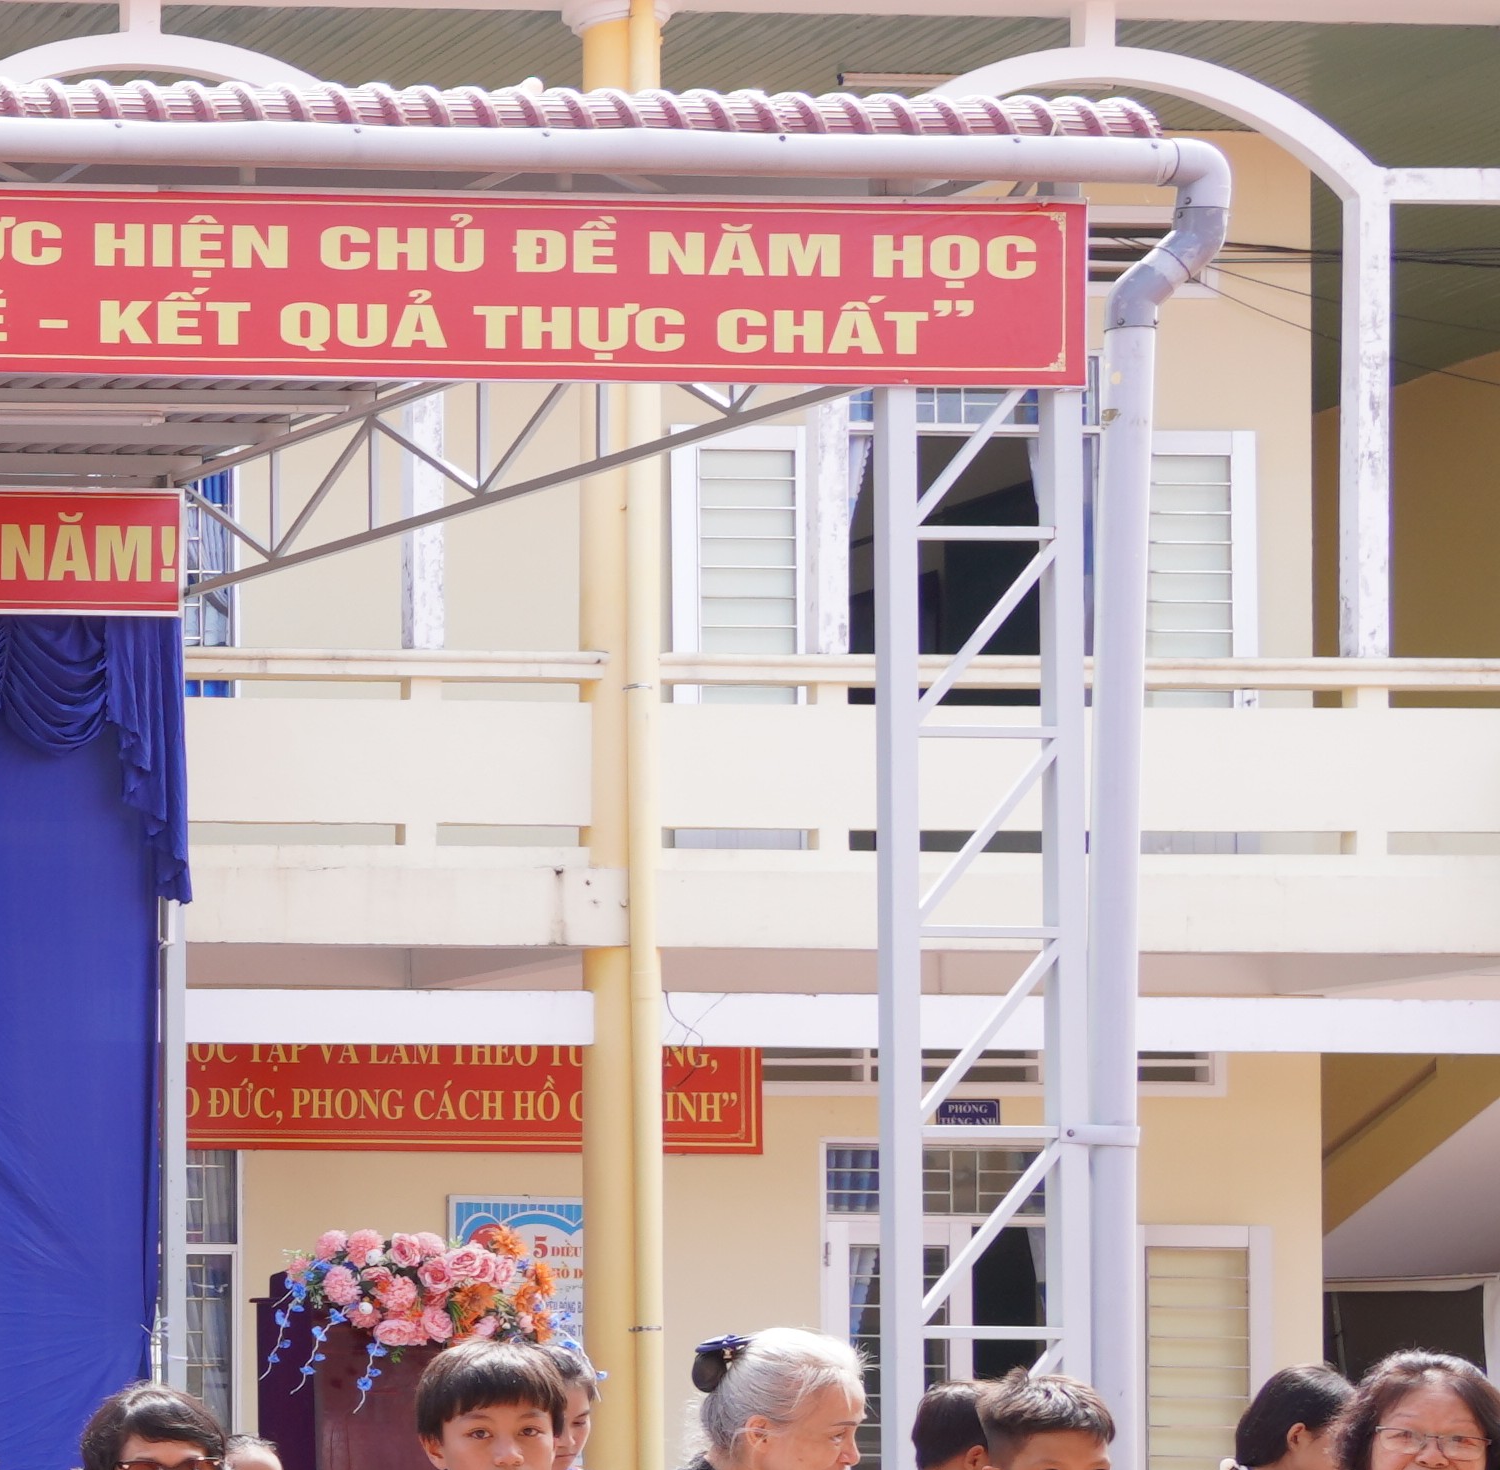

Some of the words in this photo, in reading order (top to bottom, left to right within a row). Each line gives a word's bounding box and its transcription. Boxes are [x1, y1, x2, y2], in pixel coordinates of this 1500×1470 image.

[95, 215, 288, 276] HIỆN
[320, 214, 484, 273] CHỦ
[512, 216, 617, 274] ĐỀ
[649, 223, 840, 277] NĂM
[873, 235, 1036, 290] HỌC
[100, 287, 251, 346] KẾT
[280, 289, 447, 351] QUẢ
[473, 303, 685, 361] THỰC
[1, 511, 180, 583] NĂM!
[187, 1045, 238, 1072] ỌC
[208, 1078, 284, 1125] ĐỨC,
[291, 1088, 405, 1120] PHONG
[413, 1080, 504, 1121] CÁCH
[513, 1075, 561, 1122] HỒ
[665, 1091, 738, 1123] INH”
[948, 1102, 988, 1114] PHÒNG
[533, 1235, 548, 1258] 5
